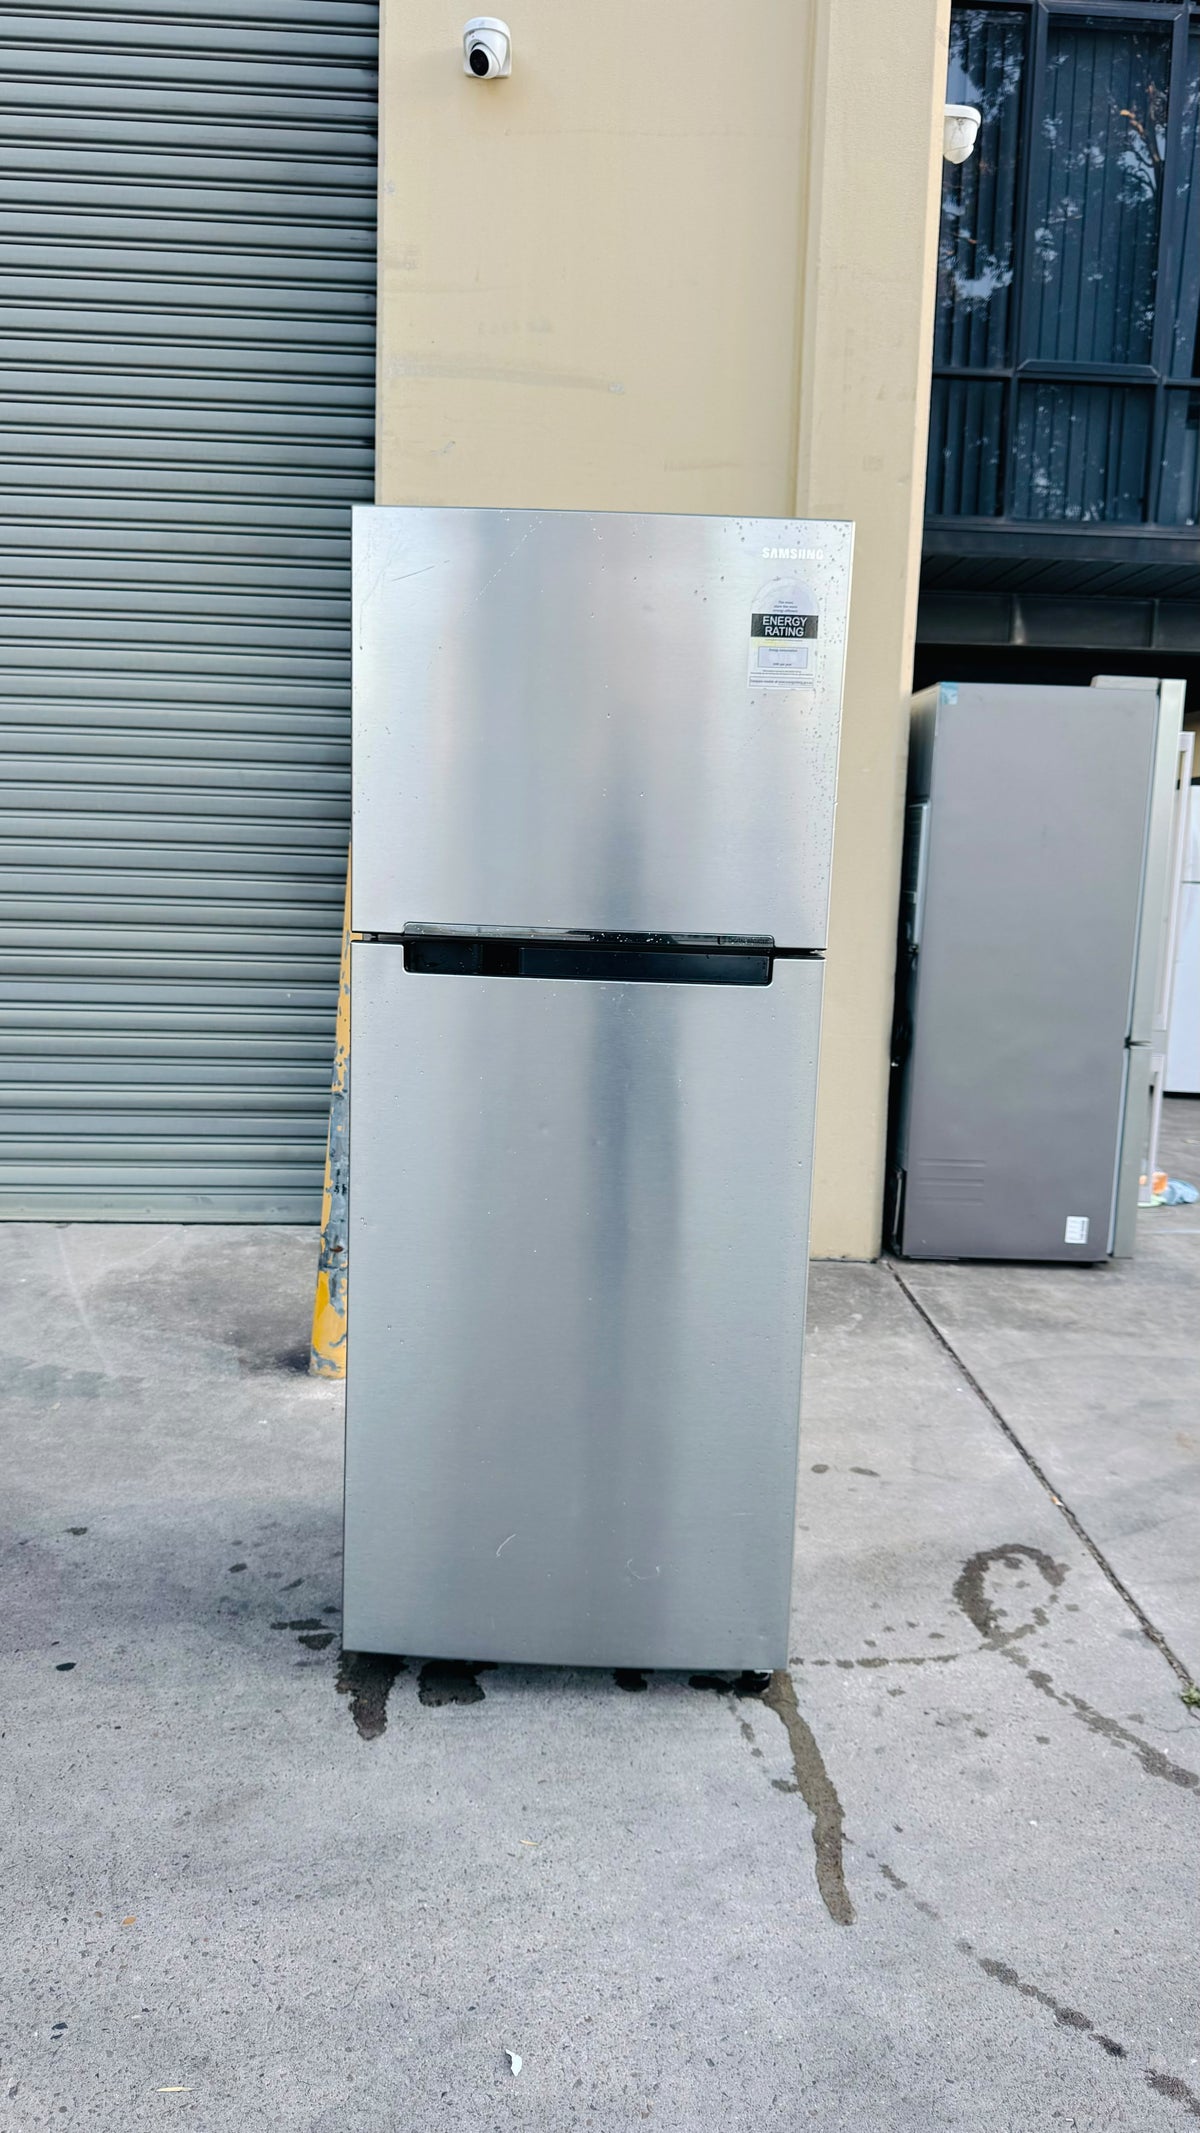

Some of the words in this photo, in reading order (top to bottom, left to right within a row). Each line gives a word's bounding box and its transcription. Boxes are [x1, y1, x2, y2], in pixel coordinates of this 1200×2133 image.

[762, 547, 824, 560] SAMSUNG
[762, 616, 808, 627] ENERGY
[764, 626, 805, 637] RATING
